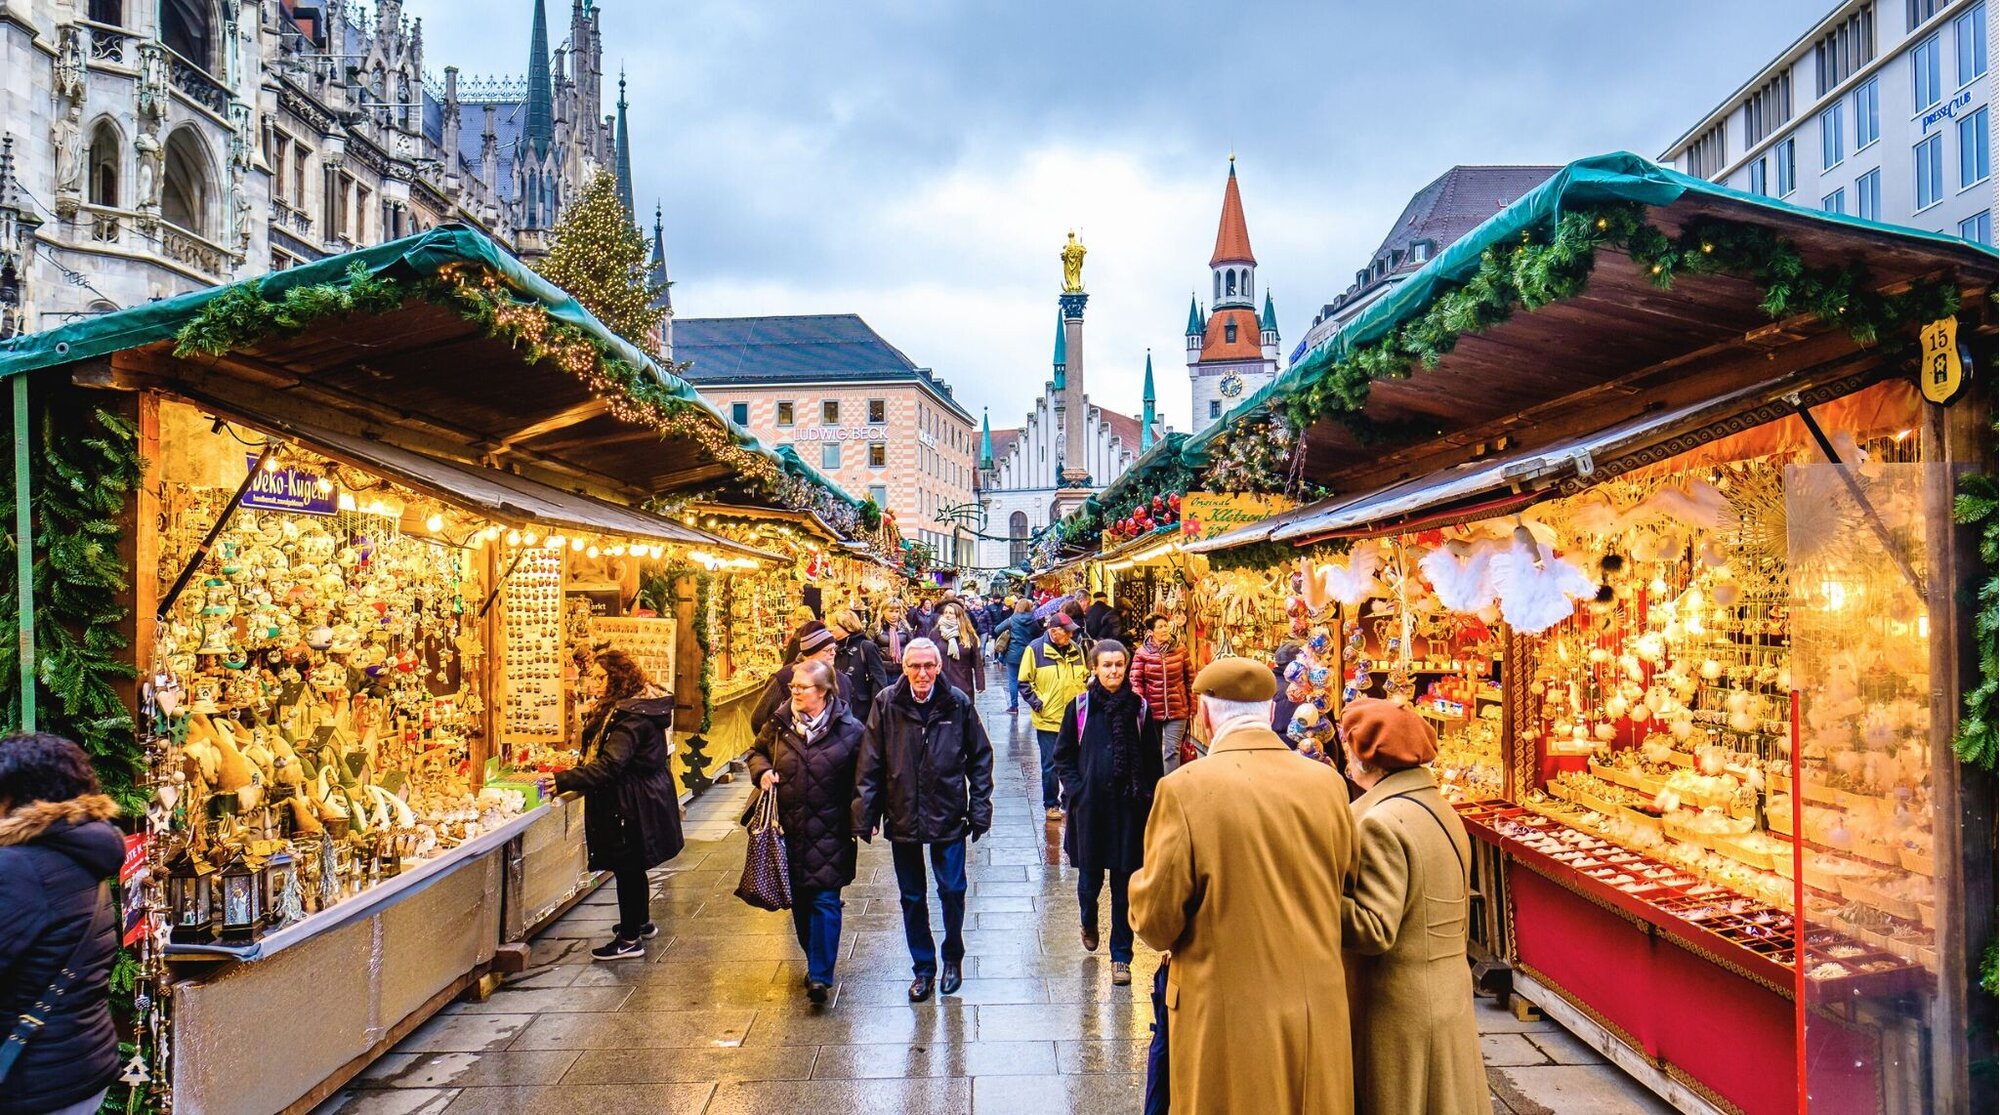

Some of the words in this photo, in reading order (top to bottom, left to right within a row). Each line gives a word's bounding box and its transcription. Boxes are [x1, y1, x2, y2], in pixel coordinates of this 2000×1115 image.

[1929, 328, 1948, 351] 15
[793, 427, 849, 441] LUDWIG
[851, 426, 889, 440] BECK
